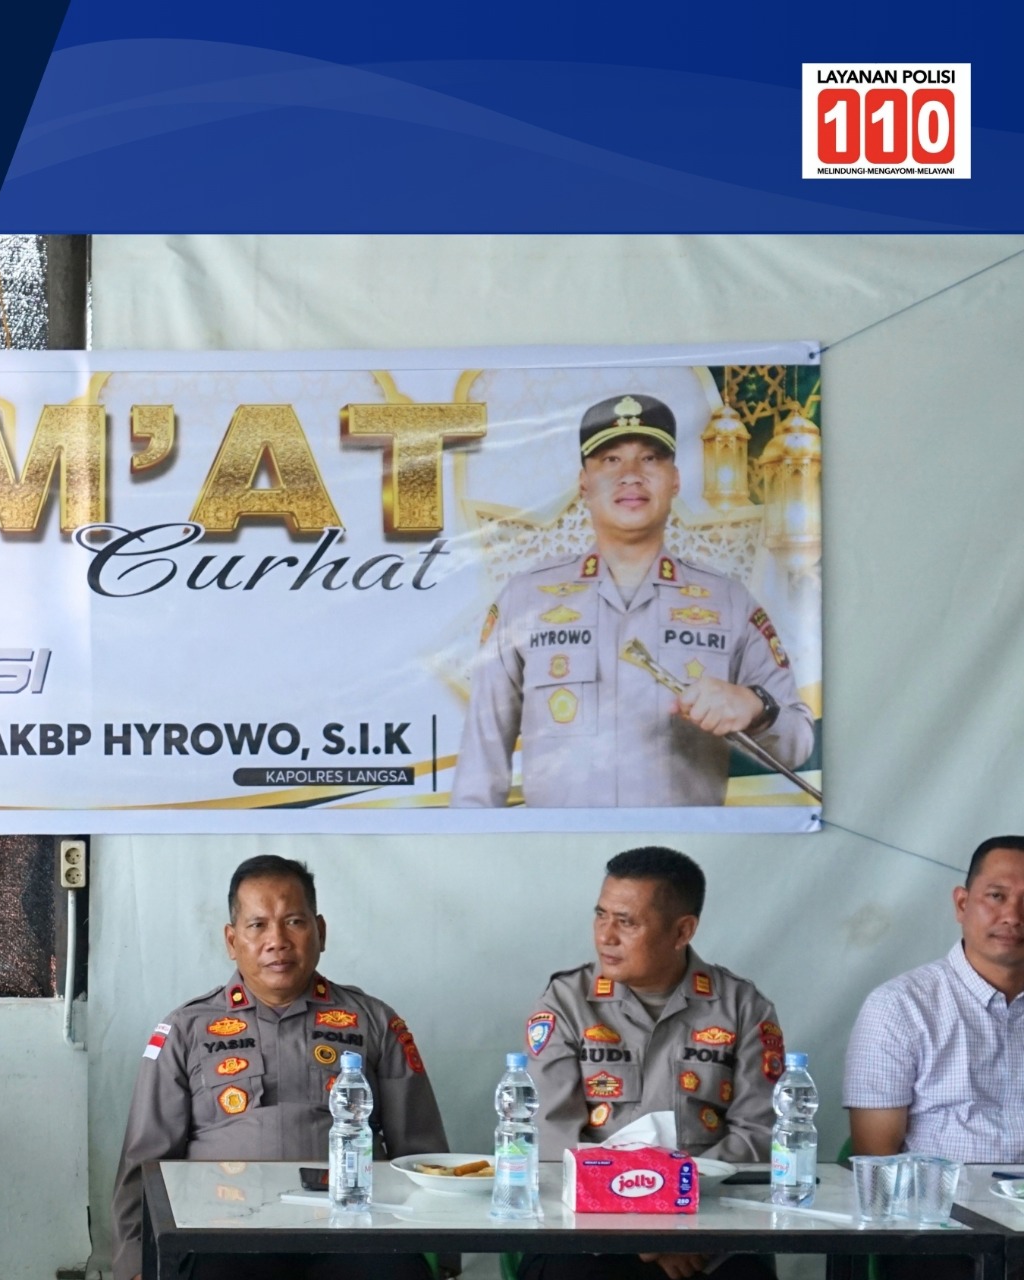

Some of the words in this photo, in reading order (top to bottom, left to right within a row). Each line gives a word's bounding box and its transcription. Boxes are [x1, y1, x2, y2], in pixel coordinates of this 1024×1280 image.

[74, 521, 450, 597] Curhat
[529, 629, 592, 648] HYROWO
[664, 630, 726, 650] POLRI
[104, 722, 310, 762] HYROWO,
[322, 722, 412, 756] S.I.K
[265, 769, 344, 784] KAPOLRES
[347, 769, 409, 784] LANGSA
[203, 1037, 256, 1054] YASIR
[311, 1031, 364, 1047] POLRI
[618, 1174, 656, 1191] jolly
